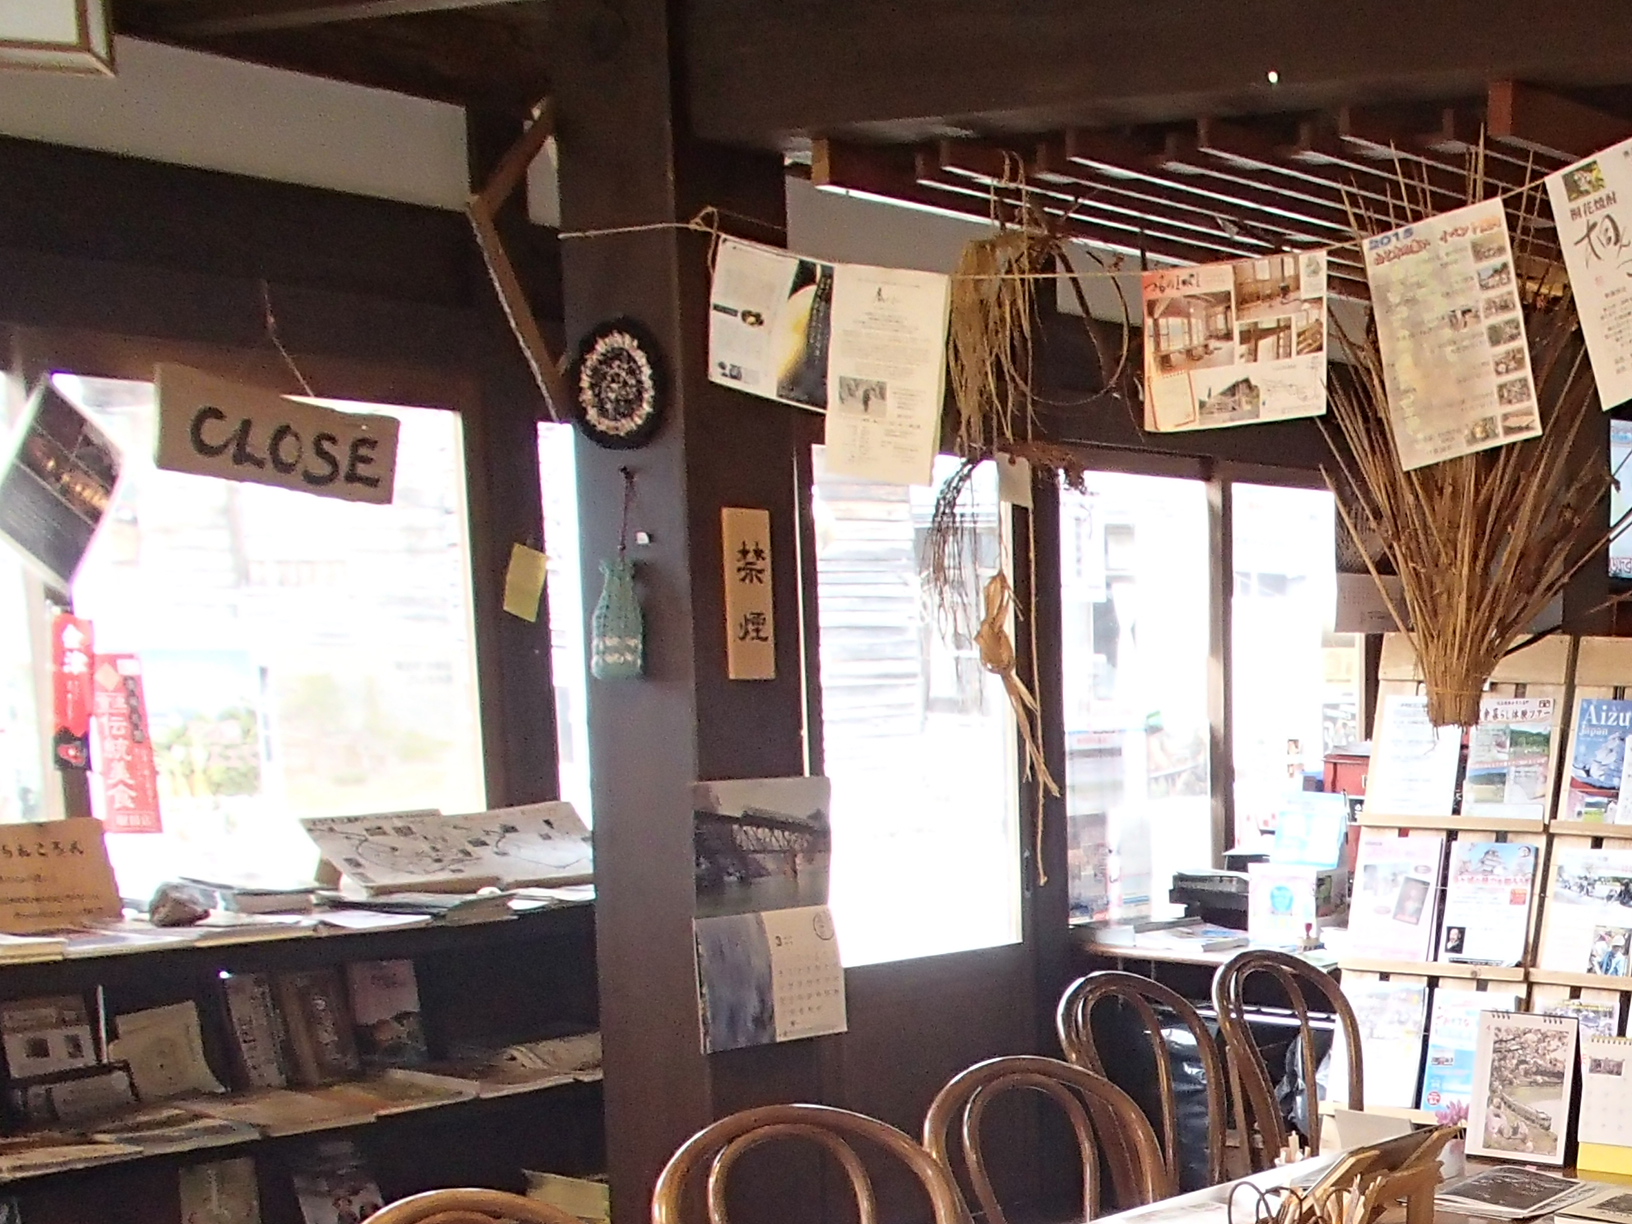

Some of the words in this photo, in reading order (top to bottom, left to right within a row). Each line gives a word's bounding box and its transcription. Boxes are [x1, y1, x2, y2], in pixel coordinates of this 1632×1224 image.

[1369, 228, 1415, 250] 2015
[190, 405, 382, 489] CLOSE
[736, 540, 769, 642] 禁煙
[1583, 704, 1632, 728] Aizu
